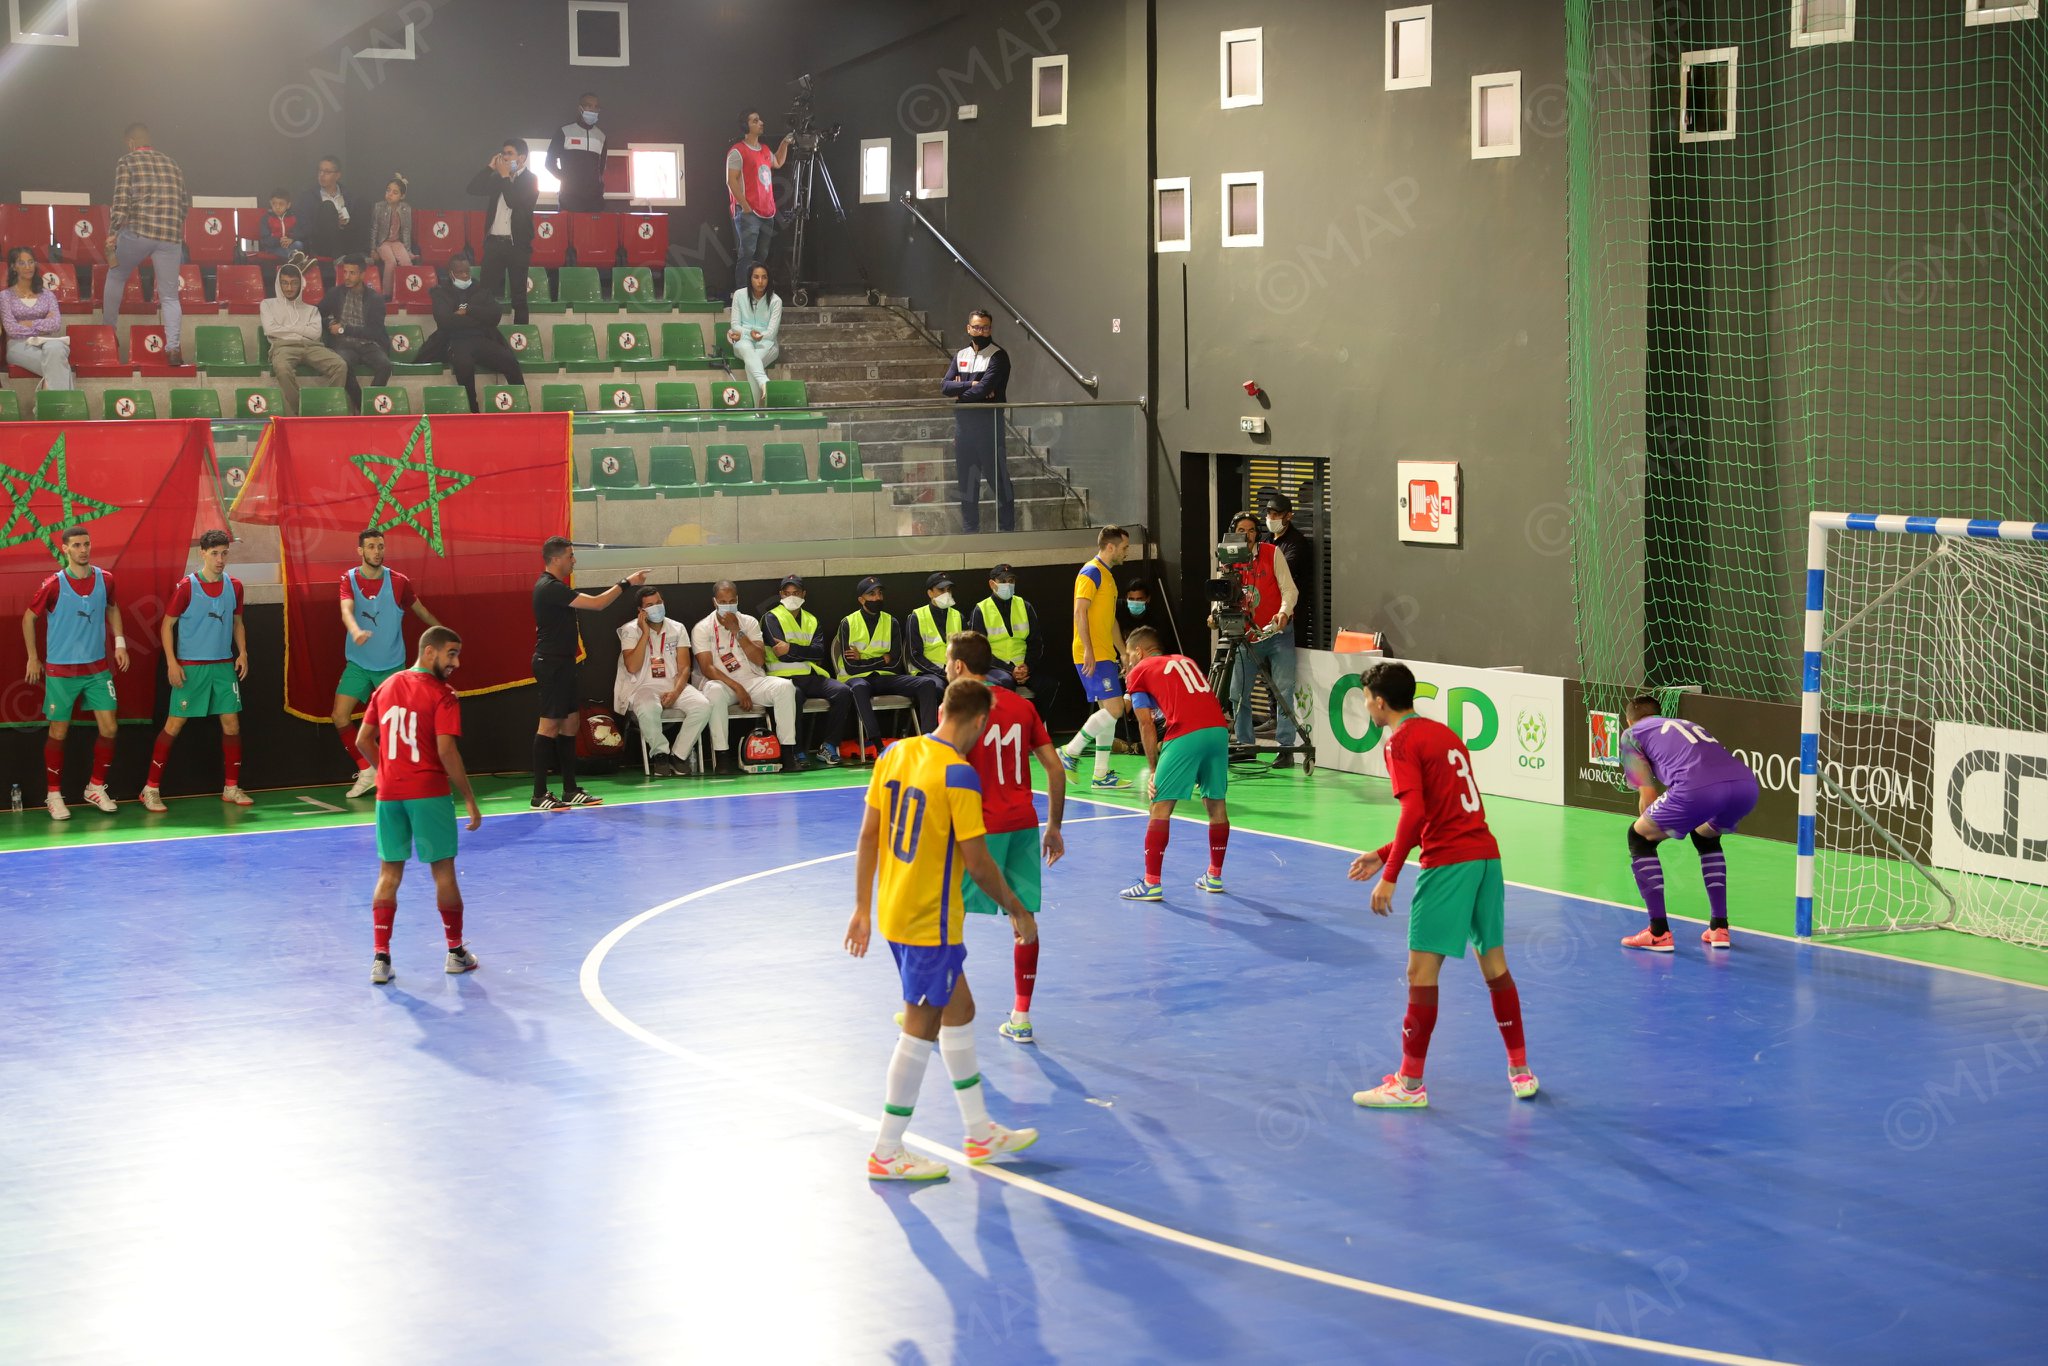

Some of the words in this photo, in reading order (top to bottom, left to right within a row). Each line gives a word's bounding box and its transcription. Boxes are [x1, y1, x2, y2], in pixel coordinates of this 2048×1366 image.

[1163, 658, 1211, 694] 10
[381, 705, 420, 763] 14
[1328, 673, 1499, 753] OP
[984, 723, 1022, 785] 11
[1448, 749, 1480, 813] 3
[1518, 754, 1545, 770] OCP
[884, 779, 927, 864] 10
